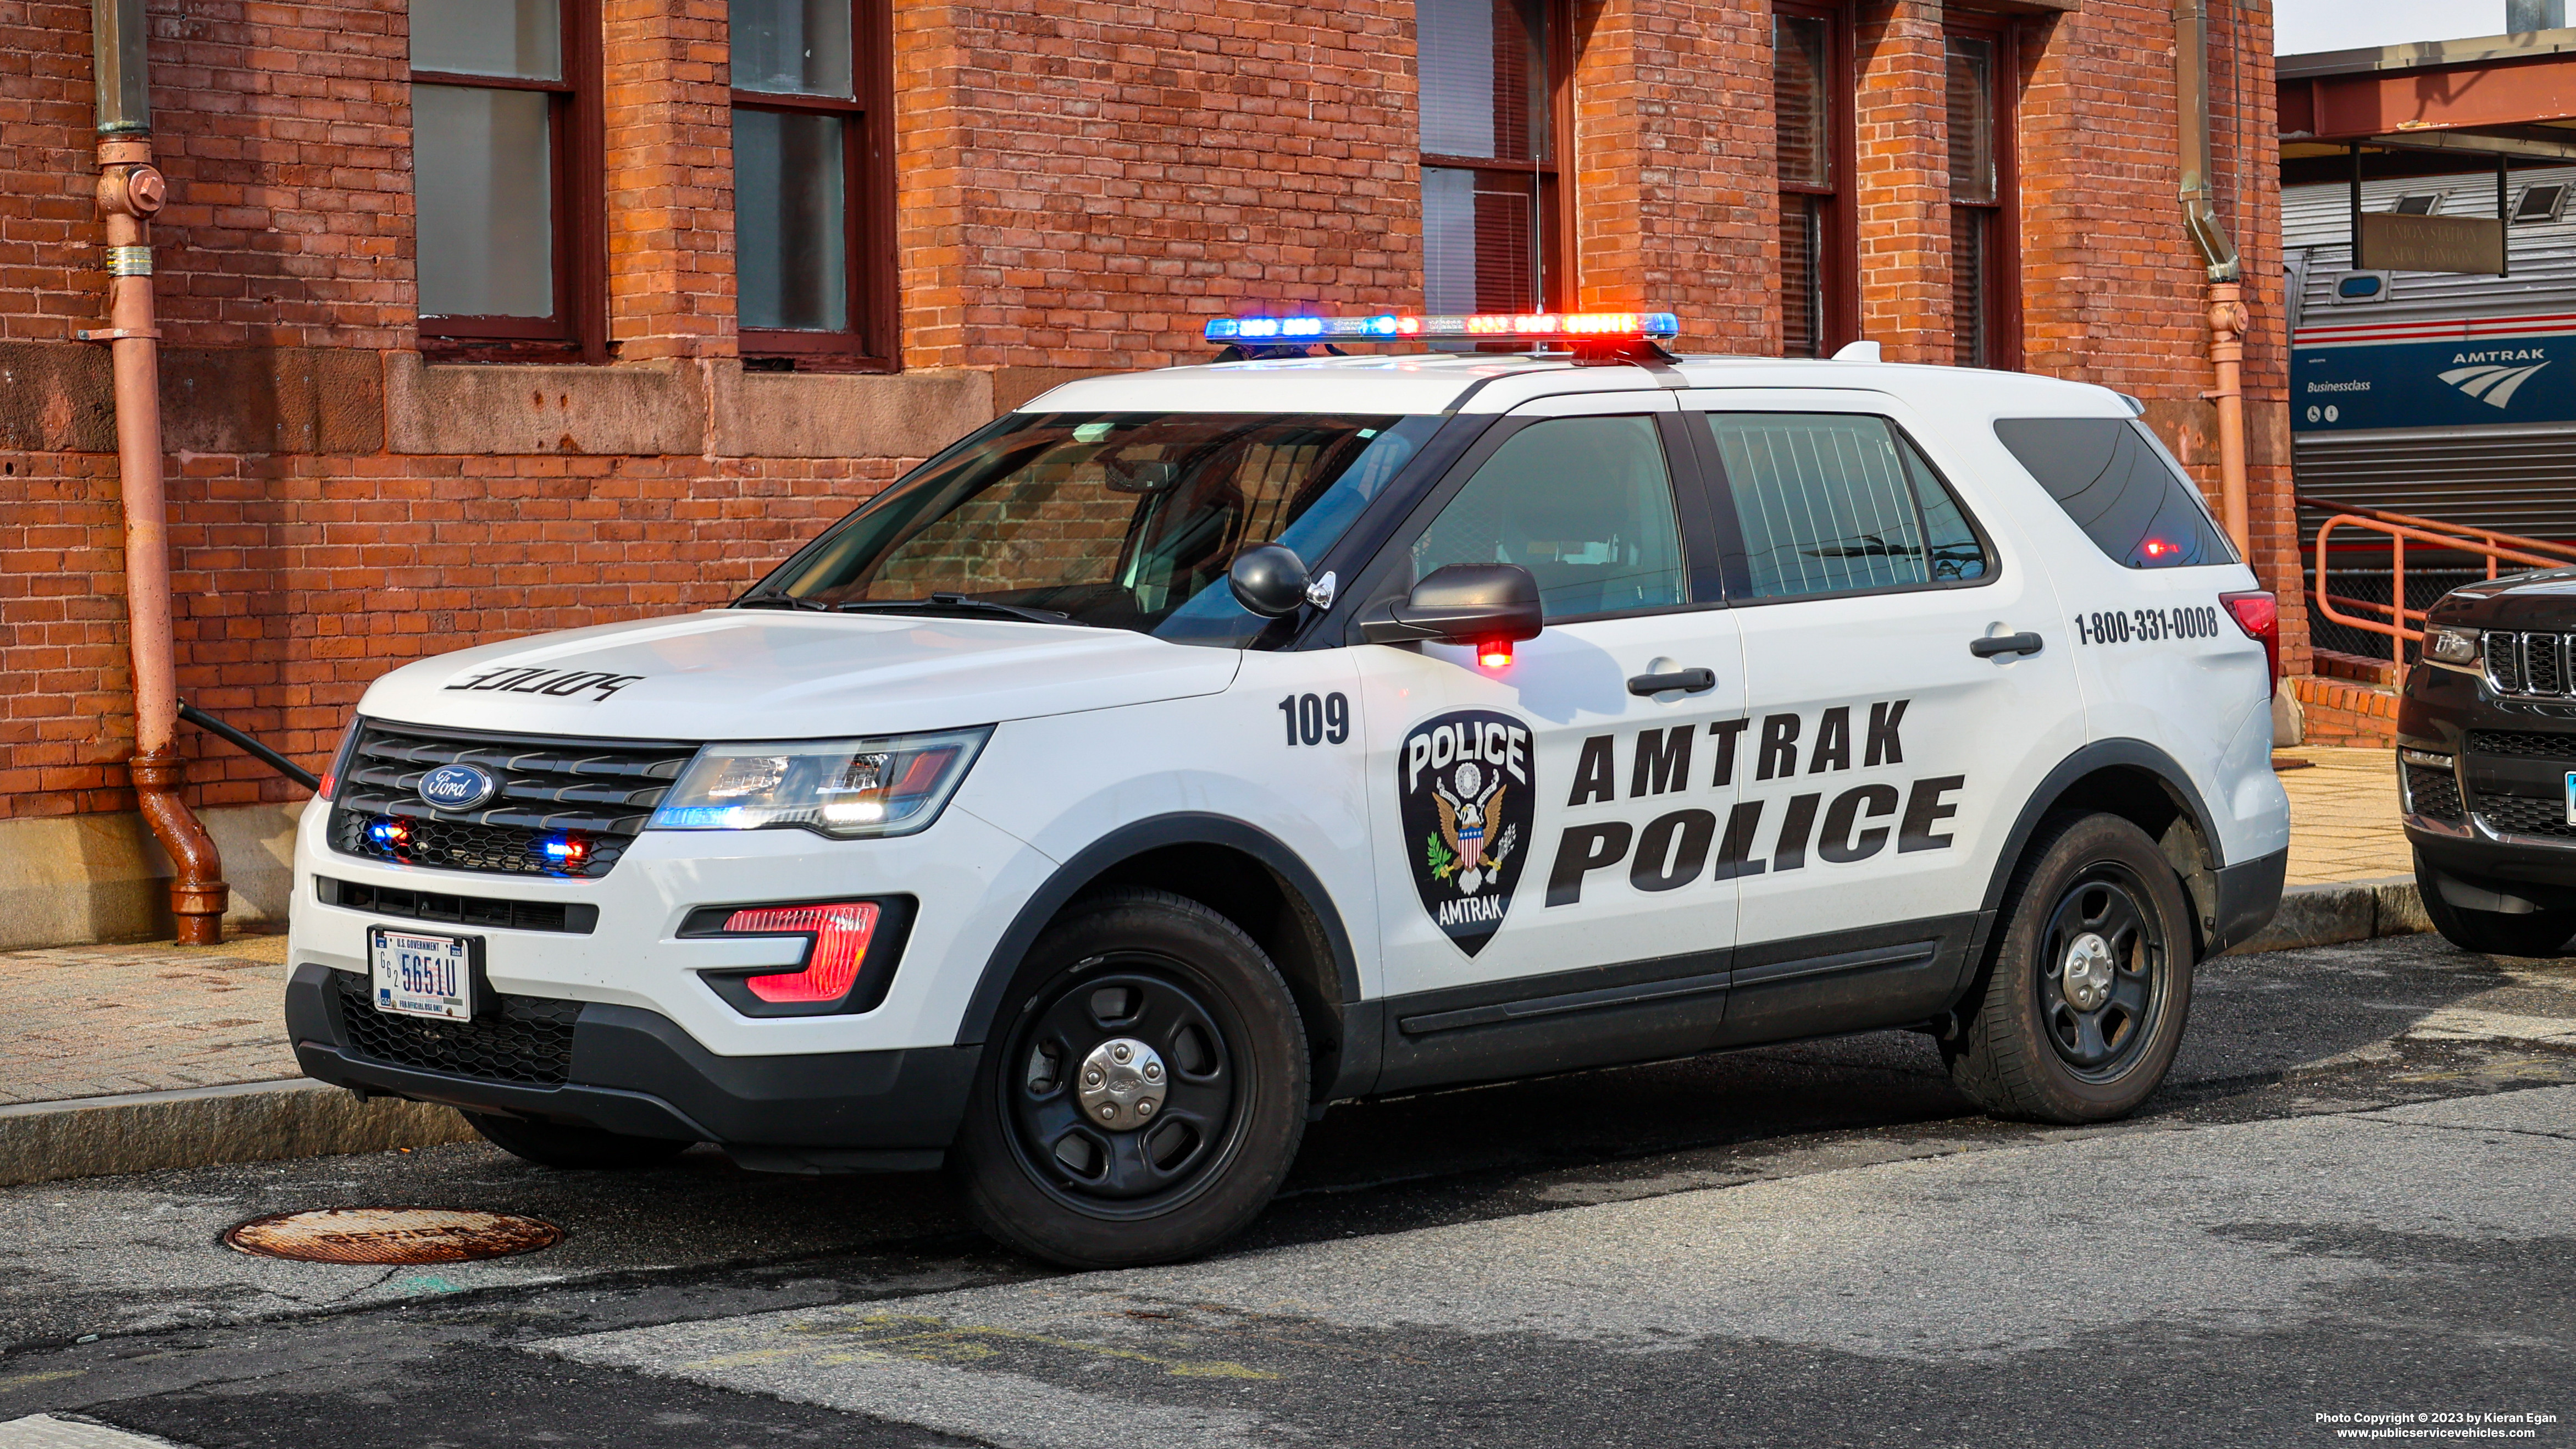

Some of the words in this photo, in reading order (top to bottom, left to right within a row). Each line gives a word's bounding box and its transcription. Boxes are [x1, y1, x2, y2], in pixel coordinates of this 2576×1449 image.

[2452, 348, 2545, 364] AMTRAK
[2307, 379, 2371, 393] Businessclass
[2074, 606, 2218, 645] 1-800-331-0008
[1278, 692, 1349, 746] 109
[1409, 721, 1526, 795] POLICE
[1566, 698, 1911, 807] AMTRAK
[428, 770, 472, 798] Ford
[1480, 786, 1493, 801] UNUM
[1544, 773, 1966, 908] POLICE
[1439, 893, 1504, 926] AMTRAK
[397, 938, 406, 948] U.S.
[407, 940, 440, 952] GOVERNMENT
[402, 954, 456, 997] 5651U
